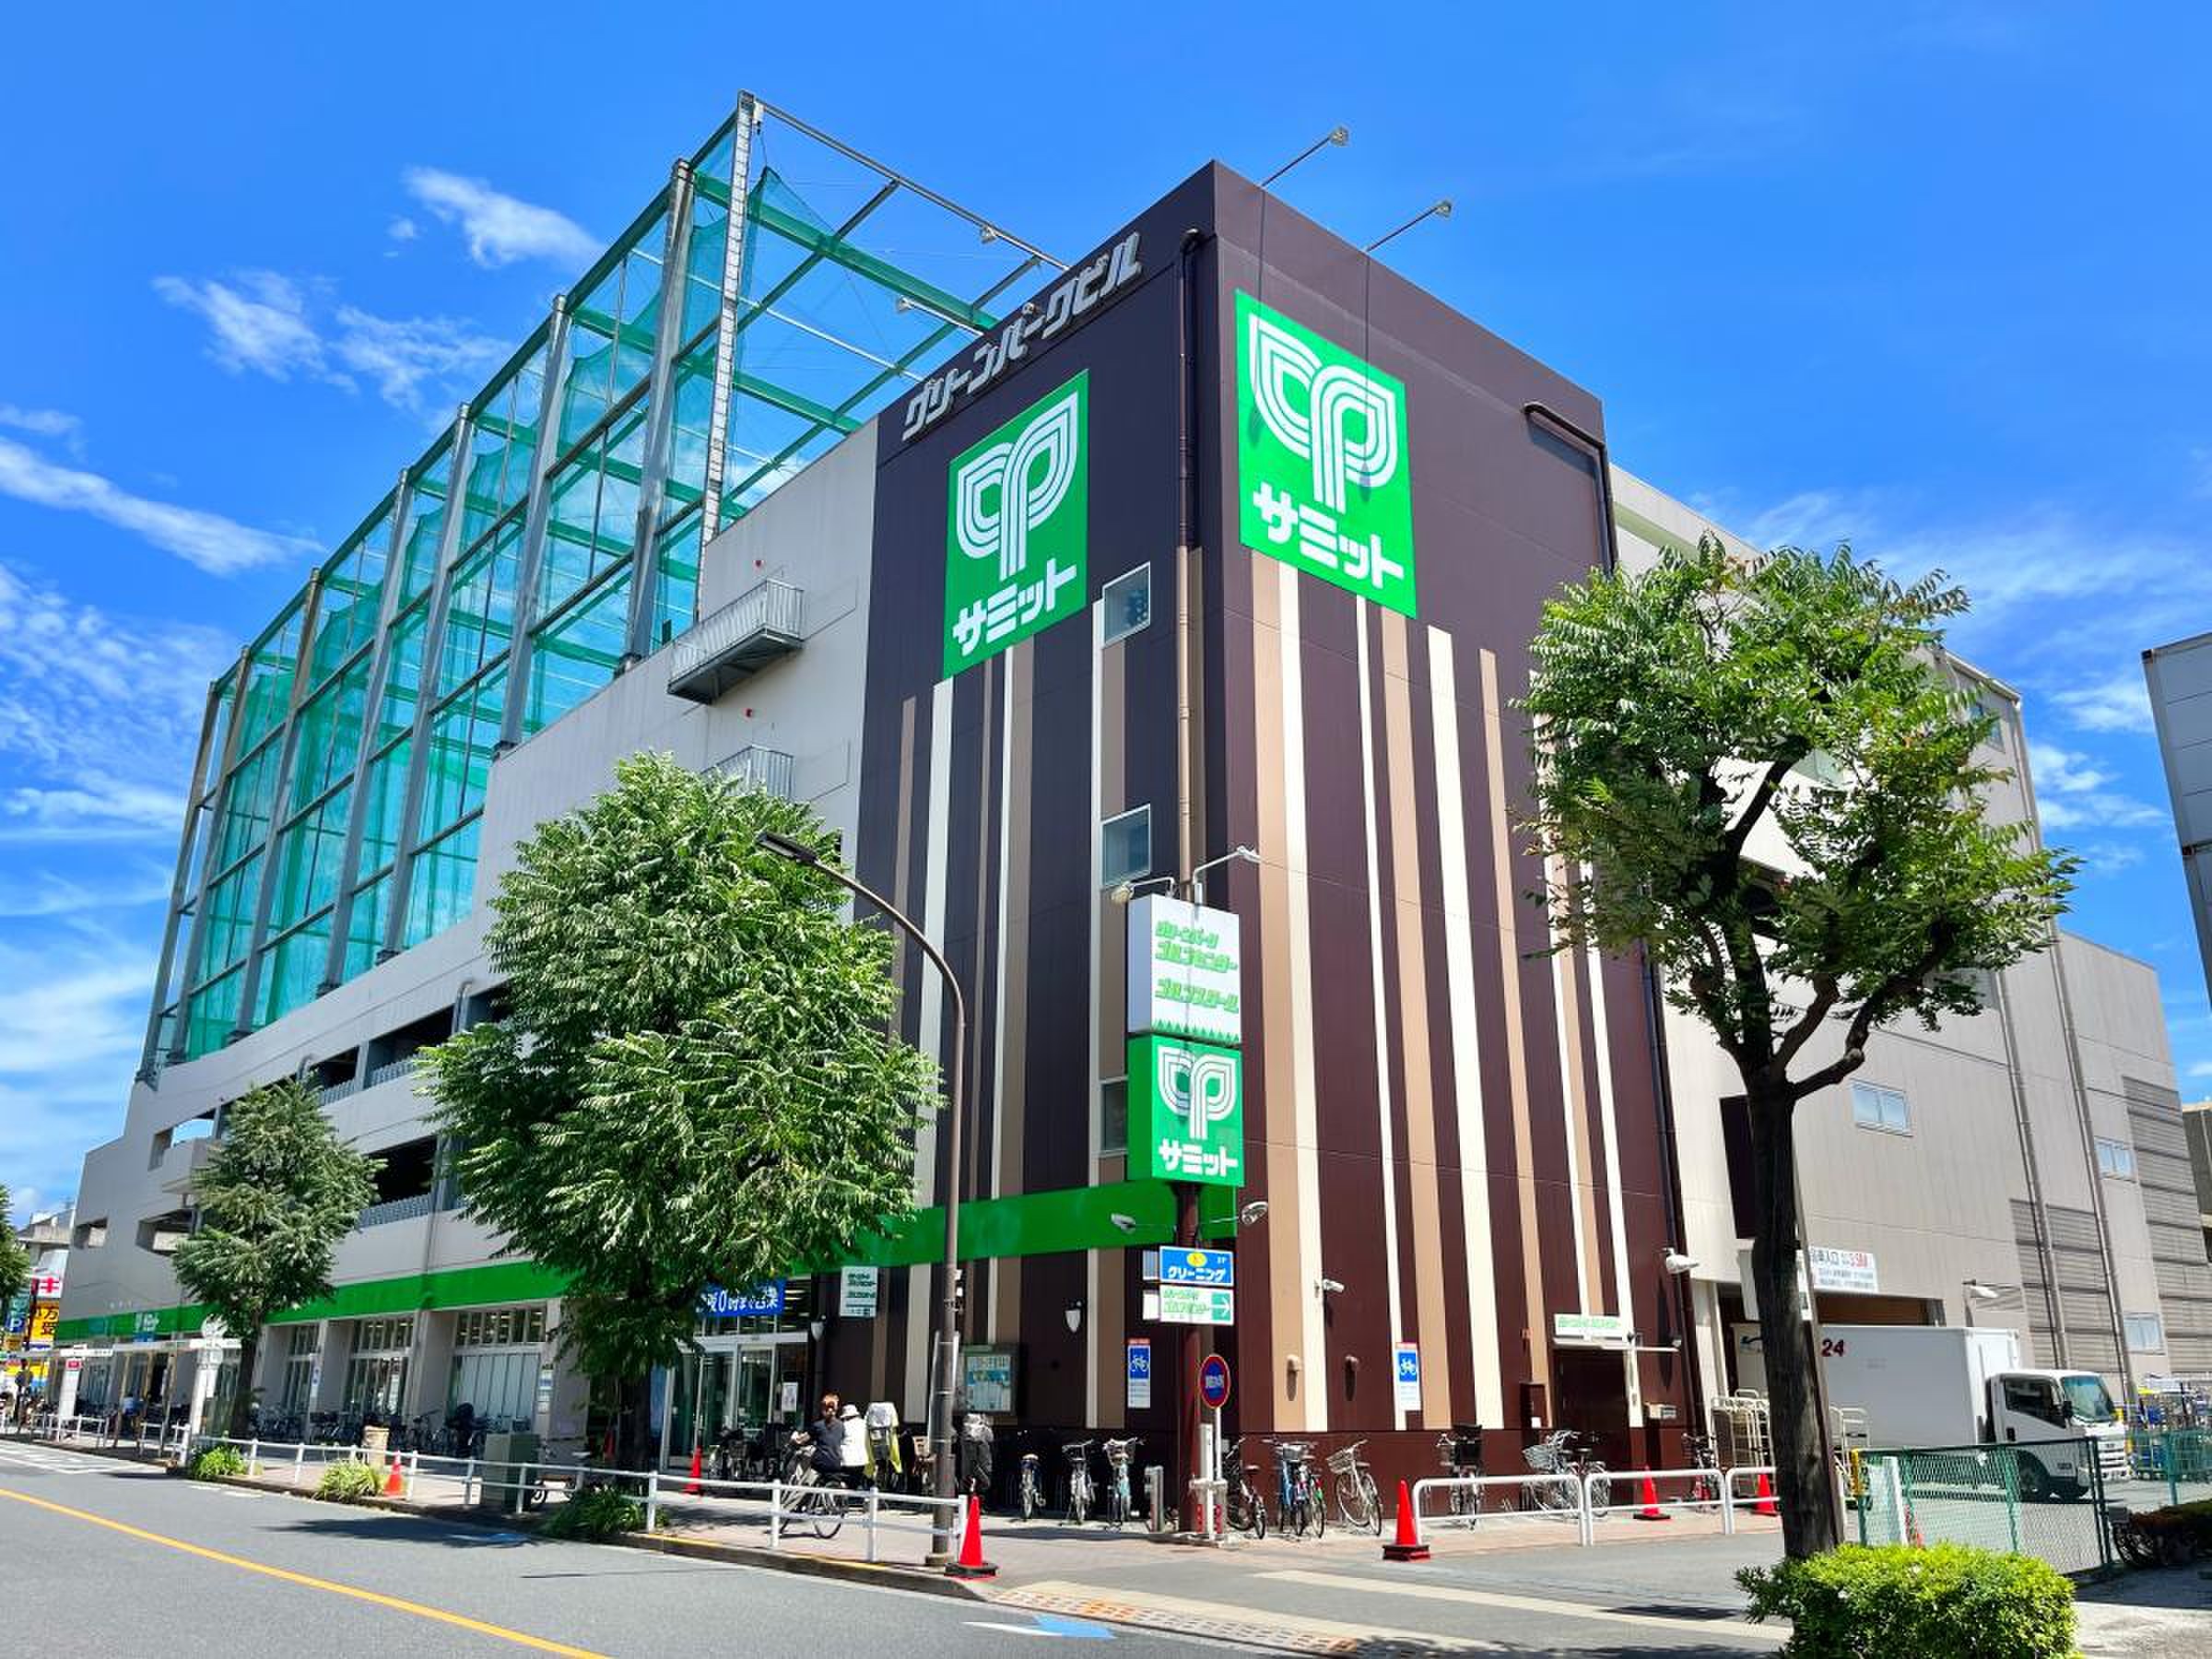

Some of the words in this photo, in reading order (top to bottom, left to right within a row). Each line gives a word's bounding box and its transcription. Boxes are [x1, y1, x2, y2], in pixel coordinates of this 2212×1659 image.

[901, 231, 1142, 441] グリーンパークビル
[1253, 481, 1405, 589] サミット
[952, 558, 1077, 657] サミット
[1158, 1139, 1238, 1178] サミット
[1168, 1265, 1226, 1282] クリーニング
[1821, 1337, 1844, 1358] 24
